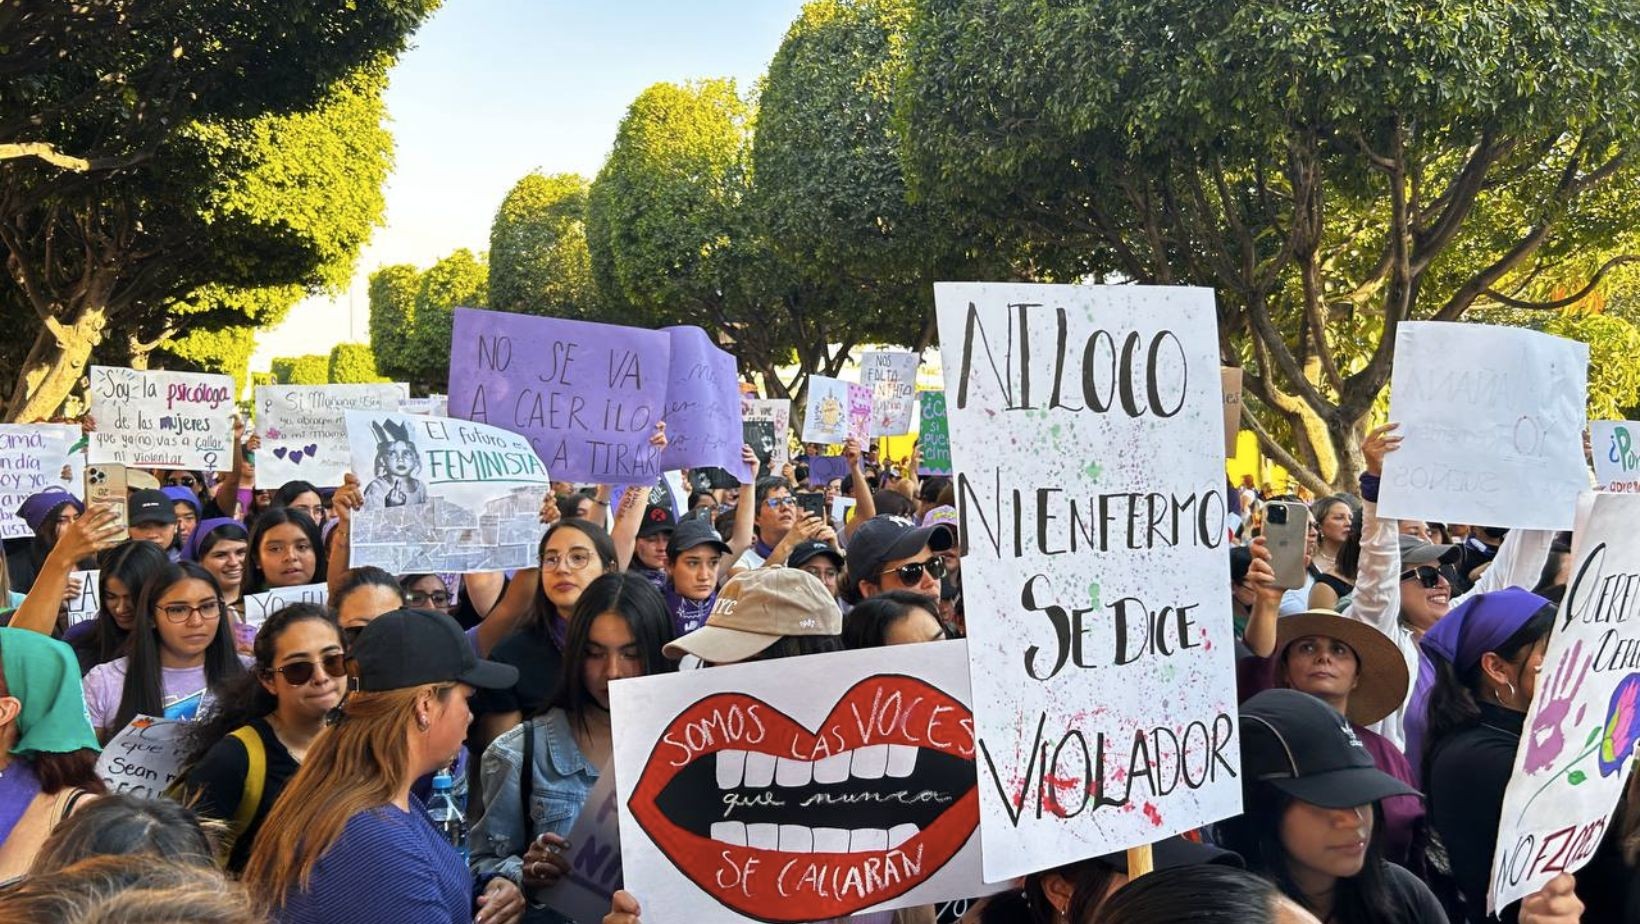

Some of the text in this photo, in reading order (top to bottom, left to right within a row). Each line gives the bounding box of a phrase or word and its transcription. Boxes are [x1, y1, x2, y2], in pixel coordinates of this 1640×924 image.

[478, 335, 512, 372] NO
[539, 340, 578, 386] SE
[608, 349, 641, 390] VA
[876, 355, 891, 367] NOS
[956, 301, 1187, 417] NI LOCO
[103, 369, 231, 410] Soy la psicóloga
[114, 406, 210, 436] de las mujeres
[469, 384, 488, 424] A
[514, 388, 585, 431] CAER
[0, 431, 46, 449] amá,
[96, 432, 116, 448] que
[121, 434, 134, 448] ya
[138, 435, 152, 446] no
[156, 436, 177, 447] vas
[181, 435, 190, 446] a
[422, 420, 449, 440] El
[459, 426, 507, 449] futuro
[0, 453, 41, 470] n día
[114, 451, 182, 465] ni violentar
[425, 450, 545, 480] FEMINISTA
[551, 440, 568, 470] A
[0, 473, 21, 489] oy
[957, 467, 1225, 558] NI ENFERMO
[1561, 542, 1640, 633] QUERE
[1021, 573, 1201, 681] SE DICE
[663, 687, 975, 767] SOMOS LAS VOCES
[108, 757, 157, 781] Sean
[978, 711, 1237, 828] VIOLADOR
[723, 790, 953, 818] que nunca
[716, 850, 760, 897] SE
